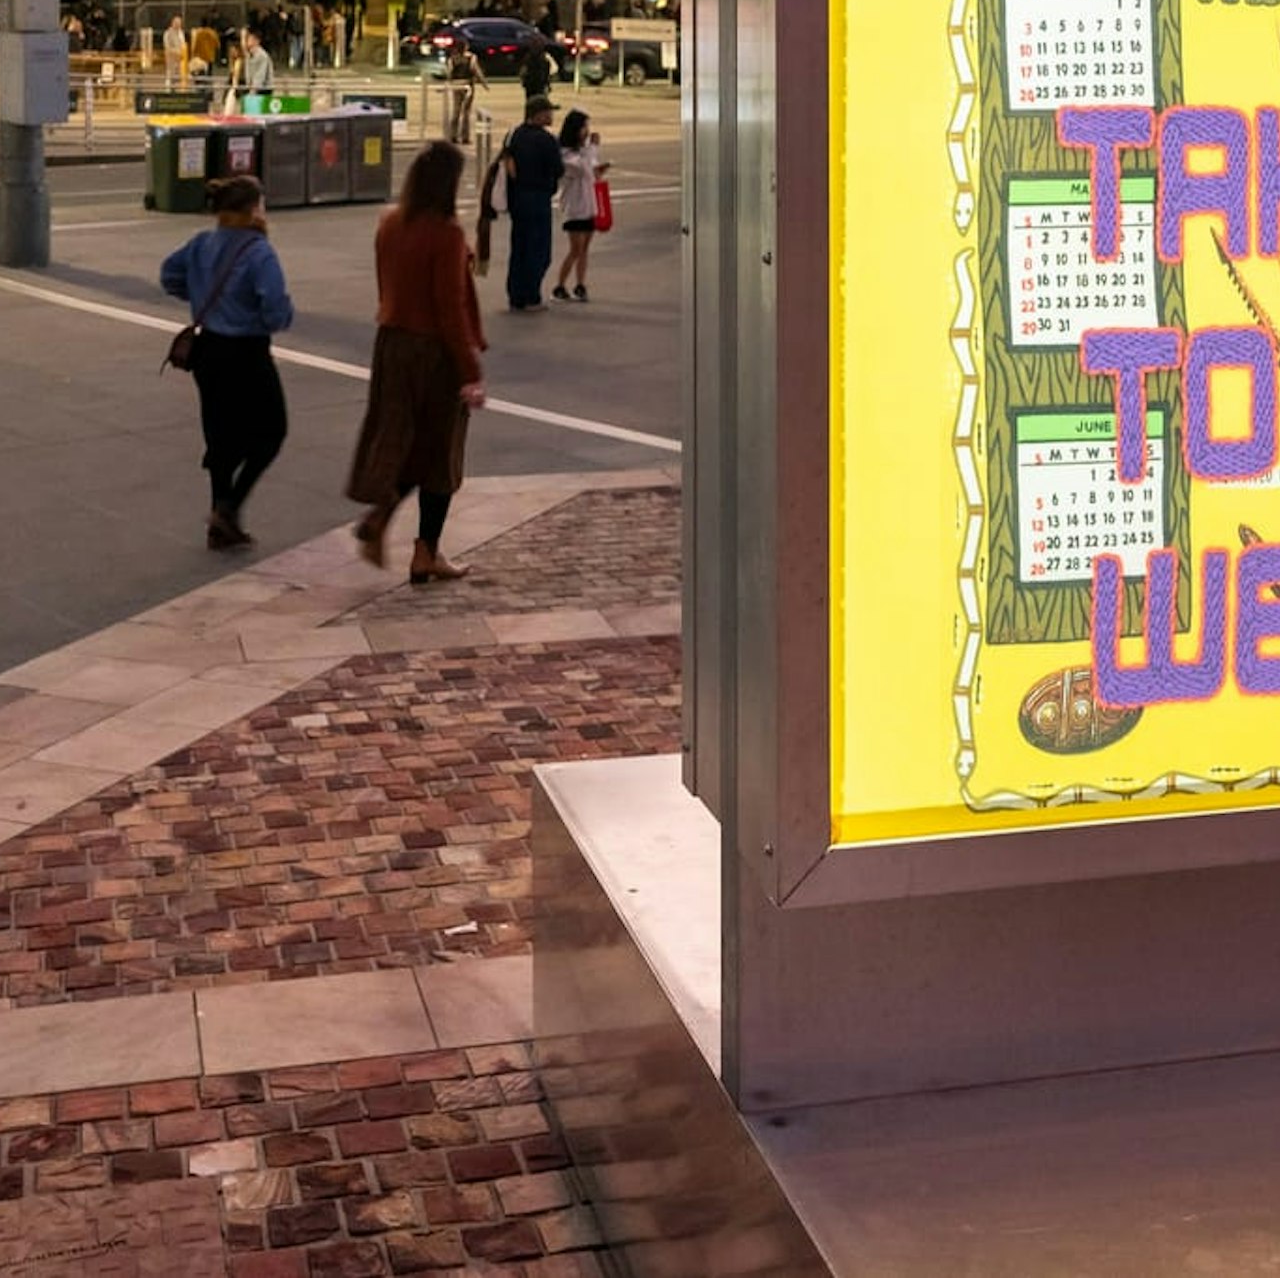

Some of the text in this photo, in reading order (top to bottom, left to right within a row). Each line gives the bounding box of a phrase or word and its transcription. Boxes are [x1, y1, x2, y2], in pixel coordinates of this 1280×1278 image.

[1025, 19, 1141, 35] 3 4 5 6 7 8 9
[1020, 40, 1141, 57] 10 11 12 13 14 15 16
[1021, 63, 1143, 78] 17 18 19 20 21 22 23
[1020, 85, 1144, 102] 24 25 26 27 28 29 30
[1071, 184, 1089, 194] MA
[1021, 295, 1146, 312] 22 23 24 25 26 27 28
[1081, 325, 1280, 485] TO
[1076, 421, 1111, 433] JUNE
[1033, 532, 1153, 553] 19 20 21 22 23 24 25
